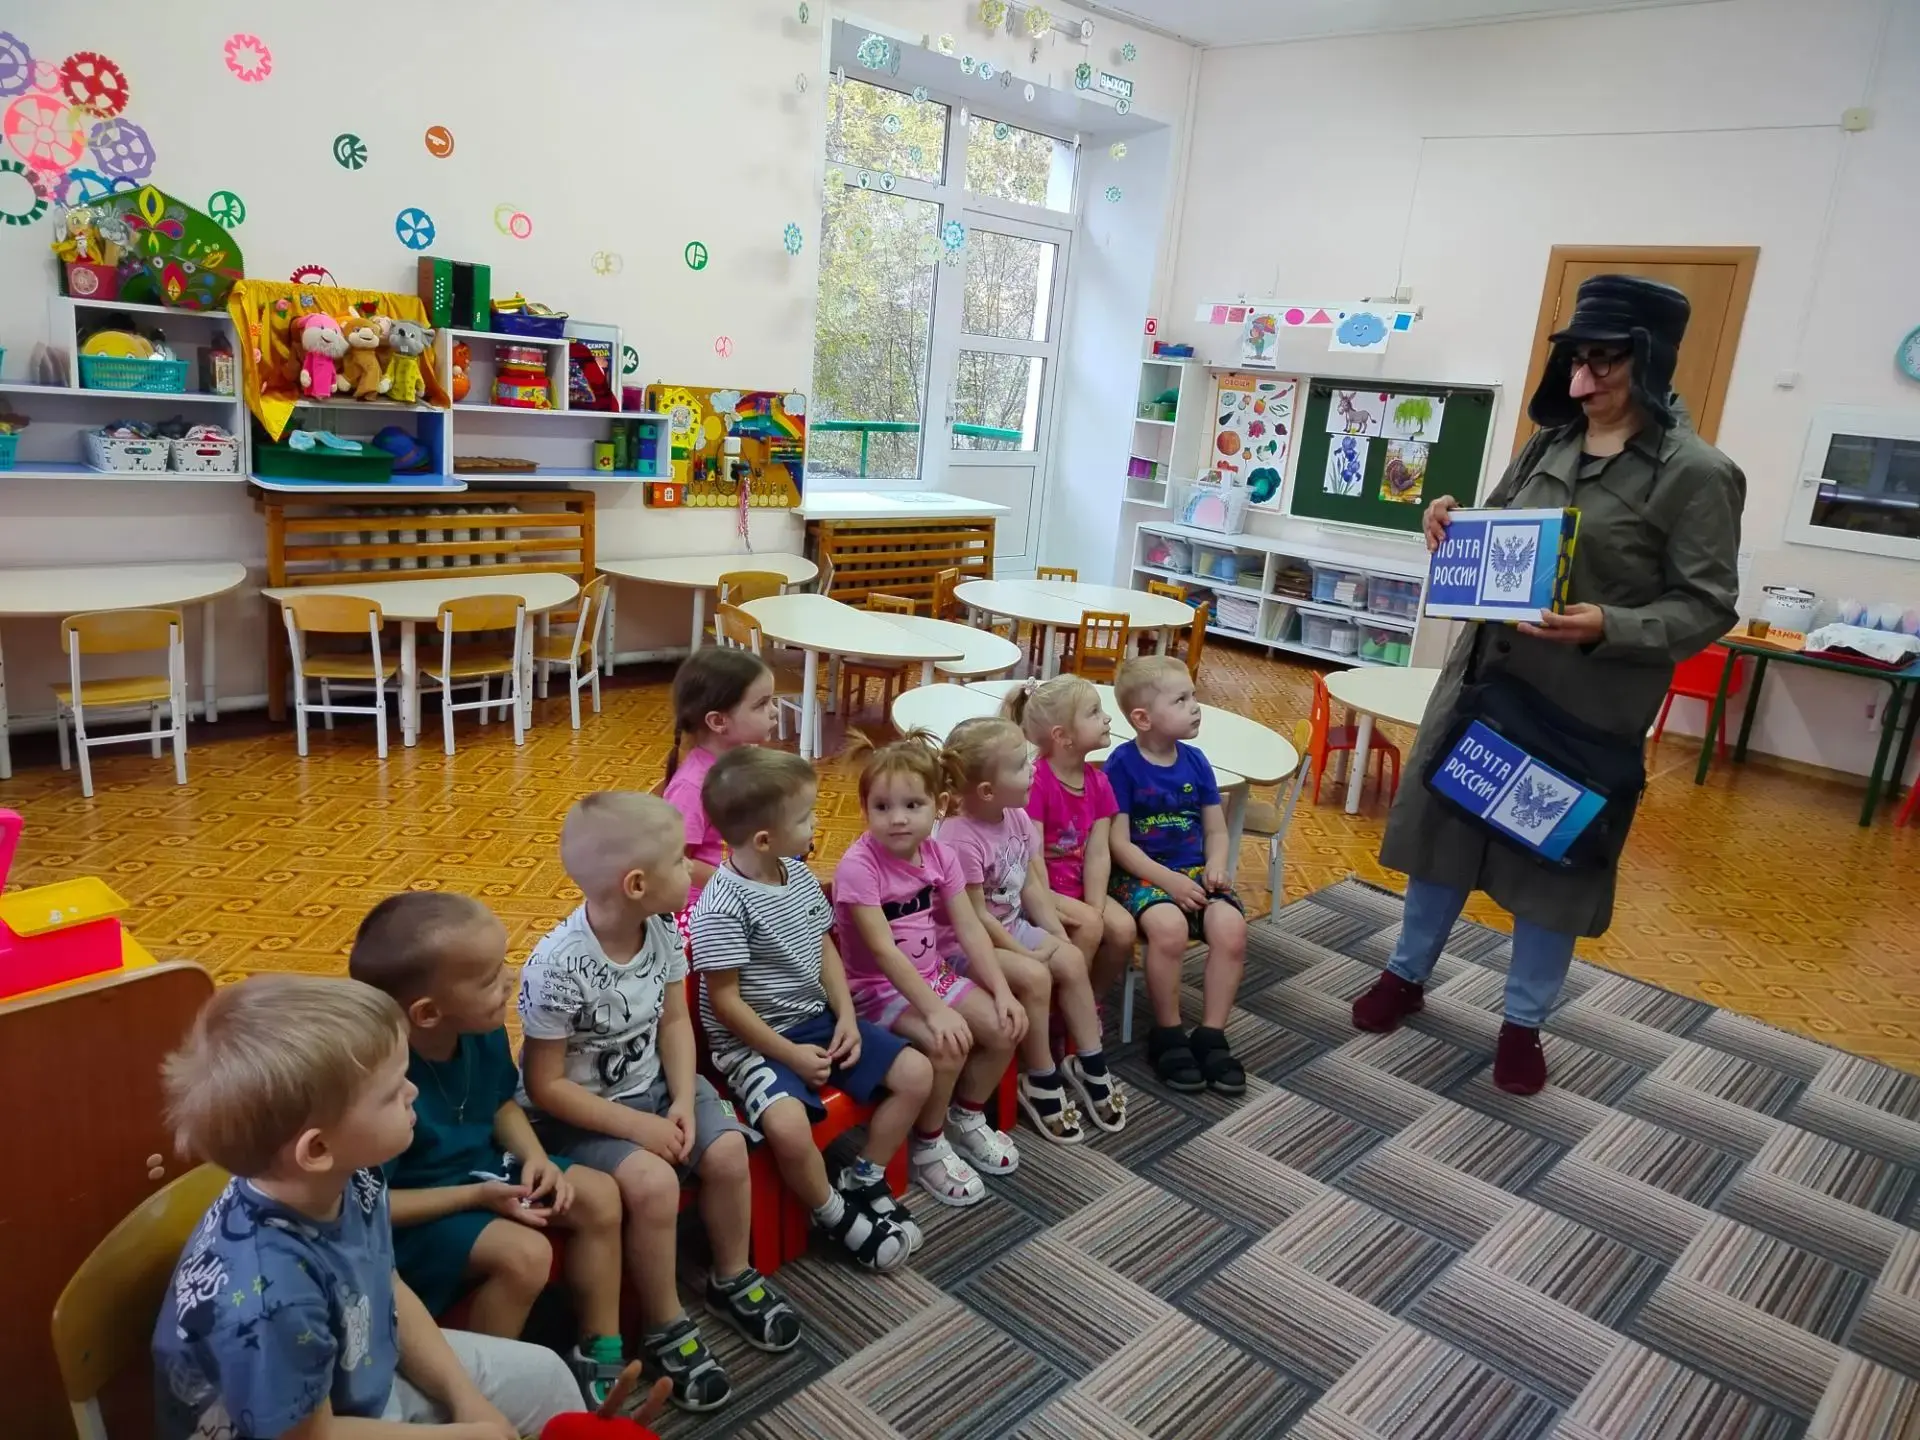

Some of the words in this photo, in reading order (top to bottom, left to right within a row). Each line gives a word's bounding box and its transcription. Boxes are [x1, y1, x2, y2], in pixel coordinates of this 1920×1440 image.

[1100, 74, 1131, 97] ВЫХОД
[1224, 379, 1250, 388] ОВОЩИ
[1437, 539, 1481, 559] ПОЧТА
[1433, 566, 1477, 587] РОССИИ
[1458, 736, 1512, 781] ПОЧТА
[1444, 757, 1498, 801] РОССИИ
